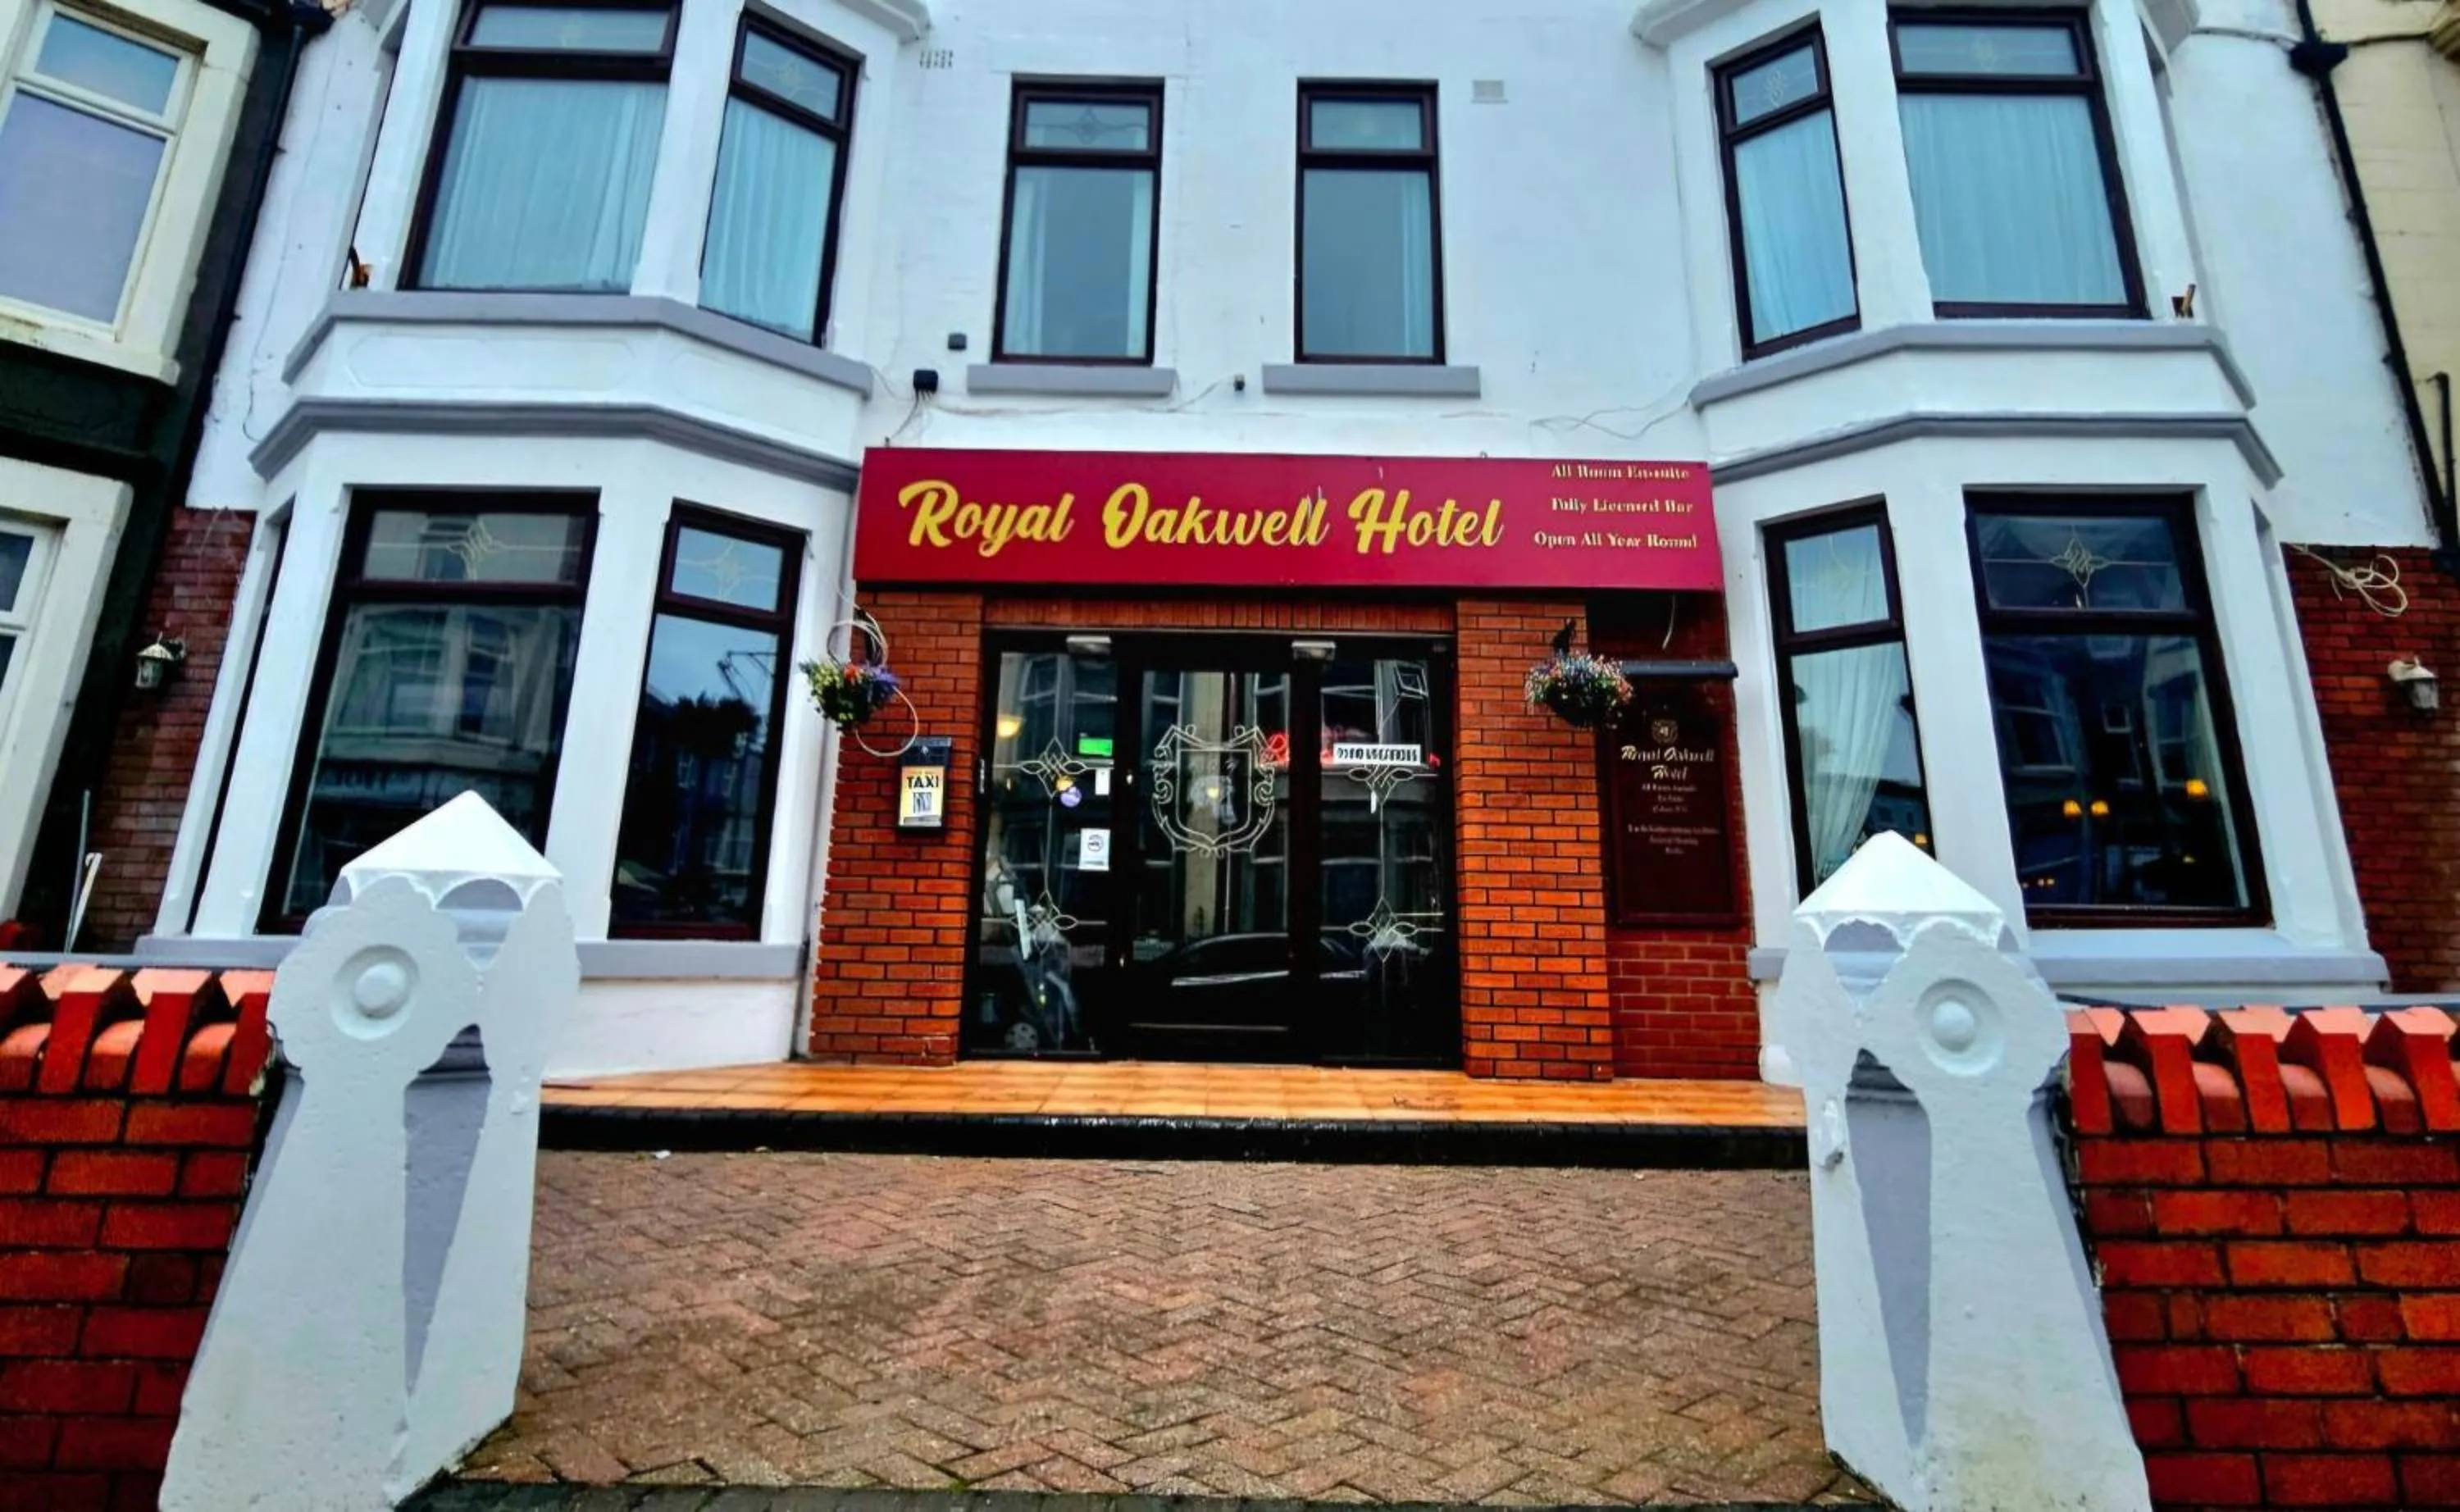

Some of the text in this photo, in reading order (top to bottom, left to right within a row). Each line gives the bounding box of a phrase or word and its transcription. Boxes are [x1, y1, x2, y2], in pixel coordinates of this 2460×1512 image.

[1551, 498, 1587, 515] Fully
[1665, 499, 1693, 513] Bar
[899, 480, 1504, 557] Royal Oakwell Hotel
[1533, 531, 1697, 549] Open All Year Round
[907, 775, 939, 789] TAXI
